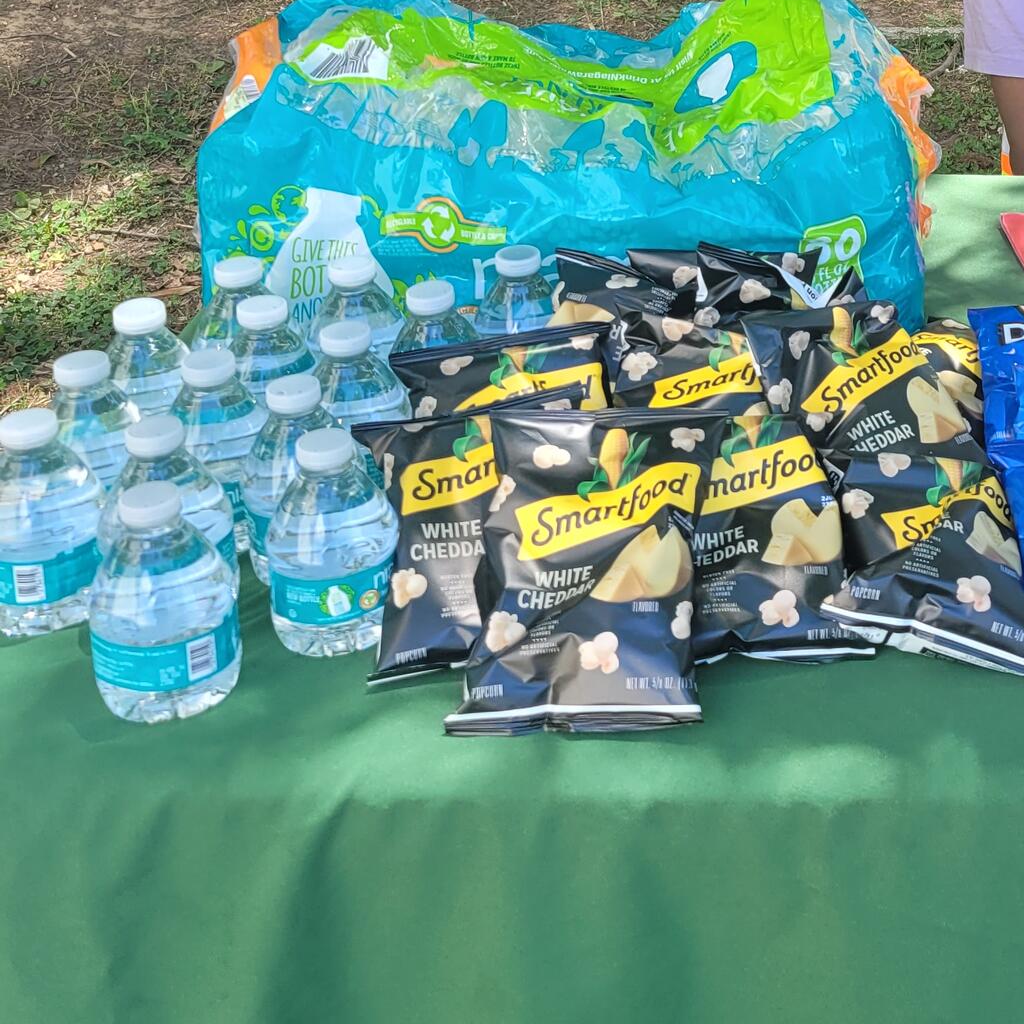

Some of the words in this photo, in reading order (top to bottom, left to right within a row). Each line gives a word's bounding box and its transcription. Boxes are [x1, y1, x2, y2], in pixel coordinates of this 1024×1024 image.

[291, 237, 324, 263] GIVE
[326, 239, 358, 261] THIS
[291, 264, 328, 300] BOT
[821, 341, 918, 415] Smartfood
[847, 410, 896, 441] WHITE
[702, 449, 814, 499] martfoo
[531, 472, 689, 547] Smartfood
[420, 519, 482, 540] WHITE
[692, 525, 745, 552] WHITE
[410, 539, 487, 562] CHEDDA
[696, 538, 759, 567] EDDAR
[535, 565, 594, 589] WHITE
[517, 578, 596, 610] CHEDDAR
[850, 585, 881, 601] POPCORN
[471, 683, 504, 699] POPCORN
